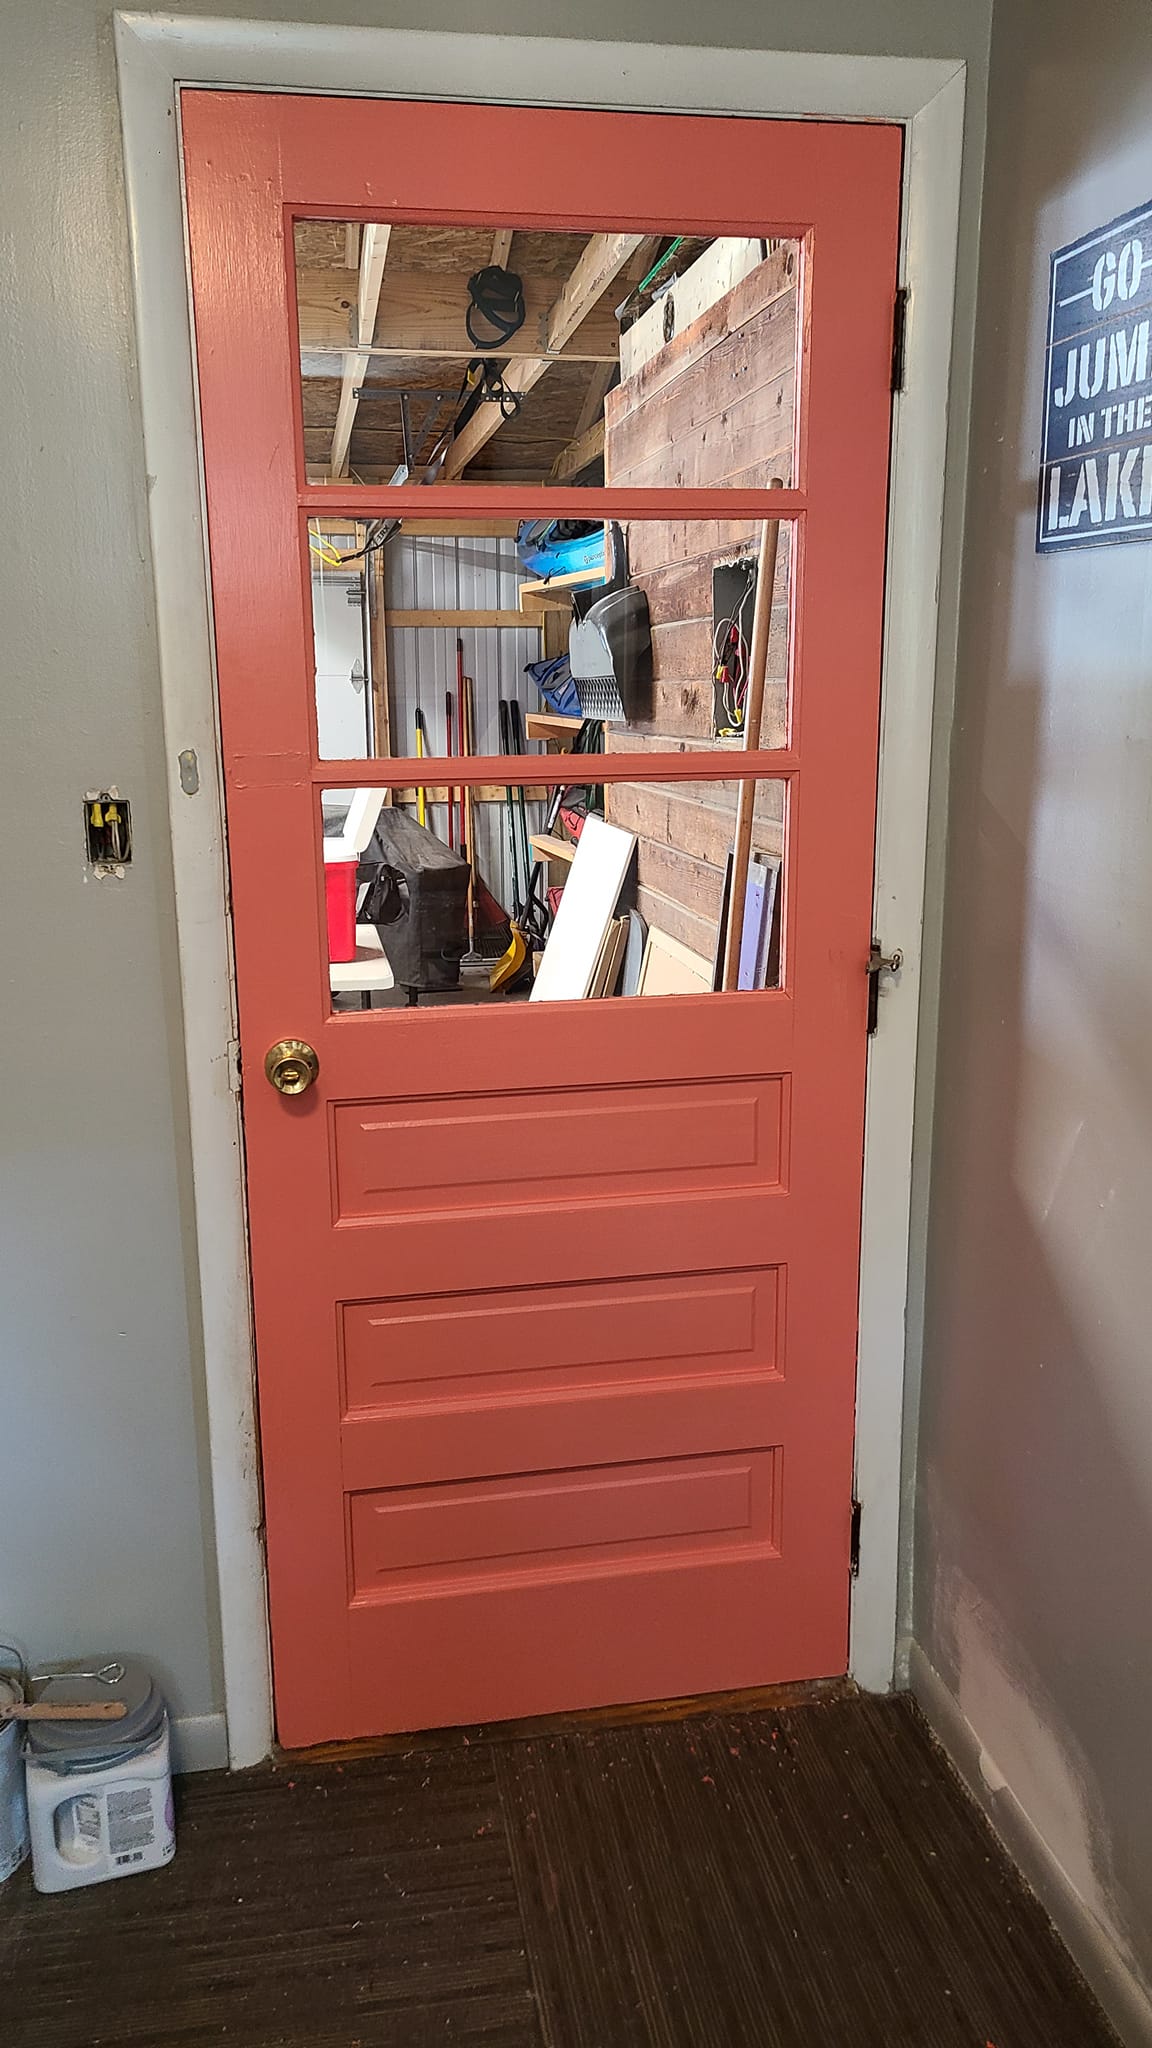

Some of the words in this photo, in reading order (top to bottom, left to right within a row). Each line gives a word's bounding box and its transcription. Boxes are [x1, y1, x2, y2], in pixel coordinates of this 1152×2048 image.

[1092, 239, 1143, 312] GO
[1054, 320, 1152, 408] JUM
[1068, 412, 1095, 448] IN
[1101, 395, 1152, 438] THE
